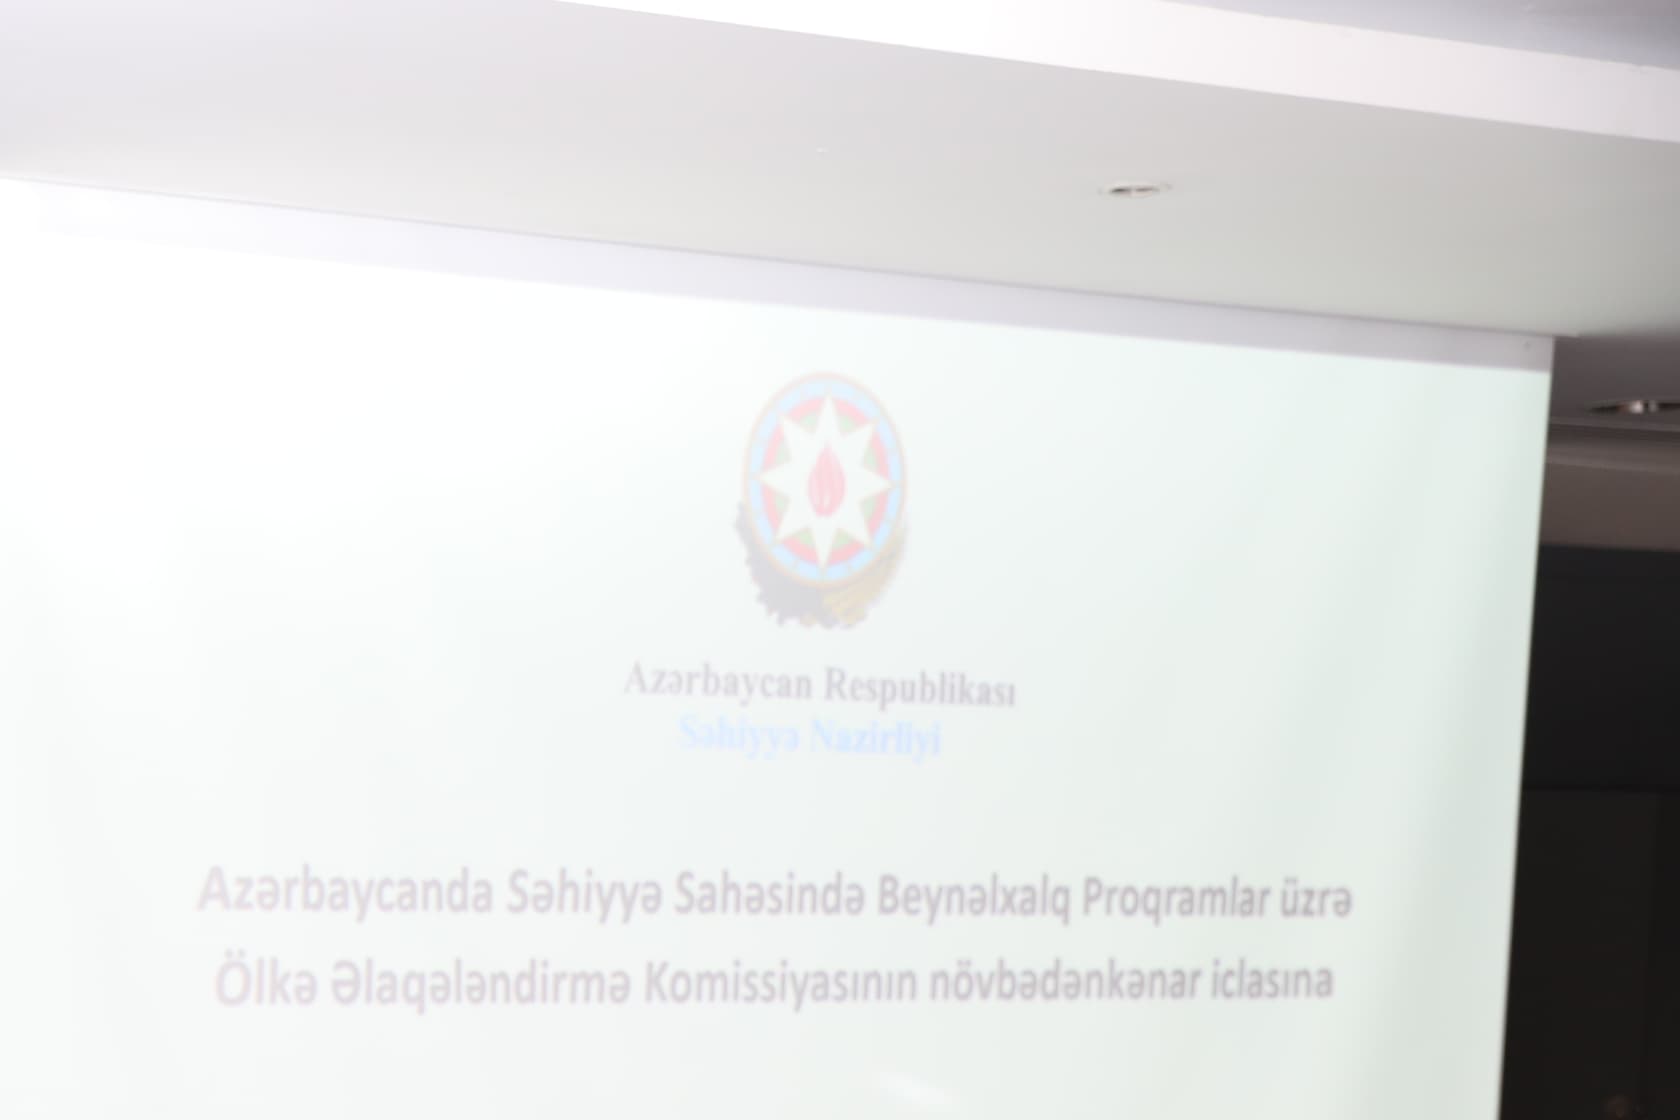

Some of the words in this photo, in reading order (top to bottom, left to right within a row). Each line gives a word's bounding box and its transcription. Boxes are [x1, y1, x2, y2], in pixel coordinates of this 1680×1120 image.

[623, 661, 813, 708] Azərbaycan
[823, 666, 1016, 713] Respublikası
[196, 863, 494, 925] Azərbaycanda
[506, 866, 664, 925] Səhiyyə
[674, 868, 866, 917] Sahəsində
[877, 871, 1071, 927] Beynəlxalq
[1082, 874, 1272, 927] Proqramlar
[1279, 876, 1353, 919] üzrə
[215, 948, 319, 1007] Ölkə
[330, 956, 632, 1017] Əlaqələndirmə
[644, 959, 919, 1014] Komissiyasının
[929, 957, 1204, 1003] növbədənkənar
[1210, 957, 1335, 1001] iclasına
